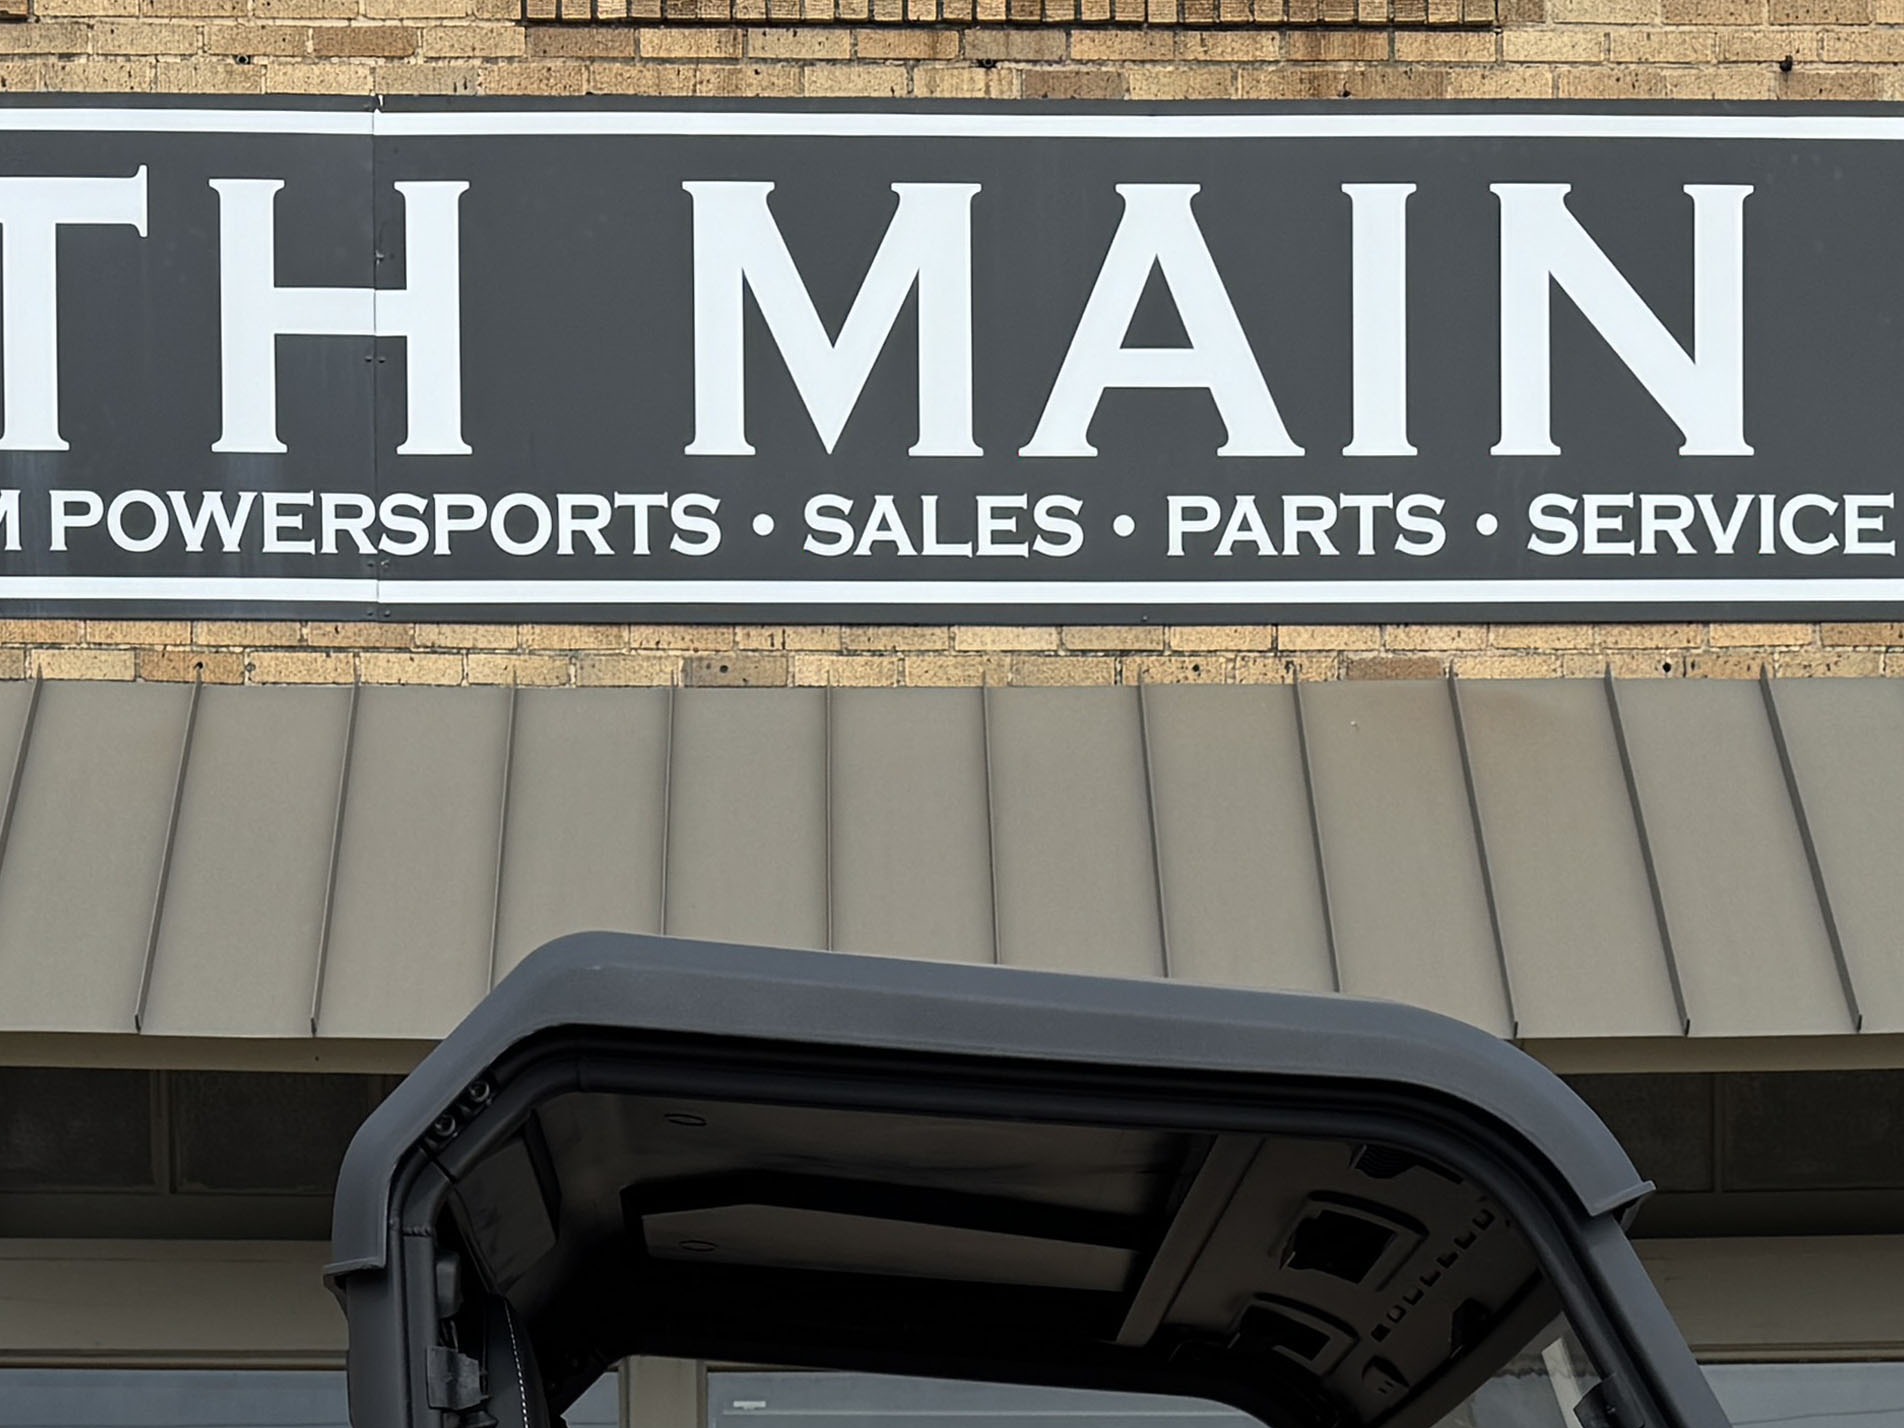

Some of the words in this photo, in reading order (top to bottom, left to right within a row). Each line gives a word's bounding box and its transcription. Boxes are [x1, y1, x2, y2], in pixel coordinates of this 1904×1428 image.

[682, 178, 1757, 459] MAIN
[49, 489, 723, 558] POWERSPORTS
[803, 493, 1086, 560] SALES
[1167, 492, 1448, 558] PARTS
[1527, 492, 1898, 558] SERVICE
